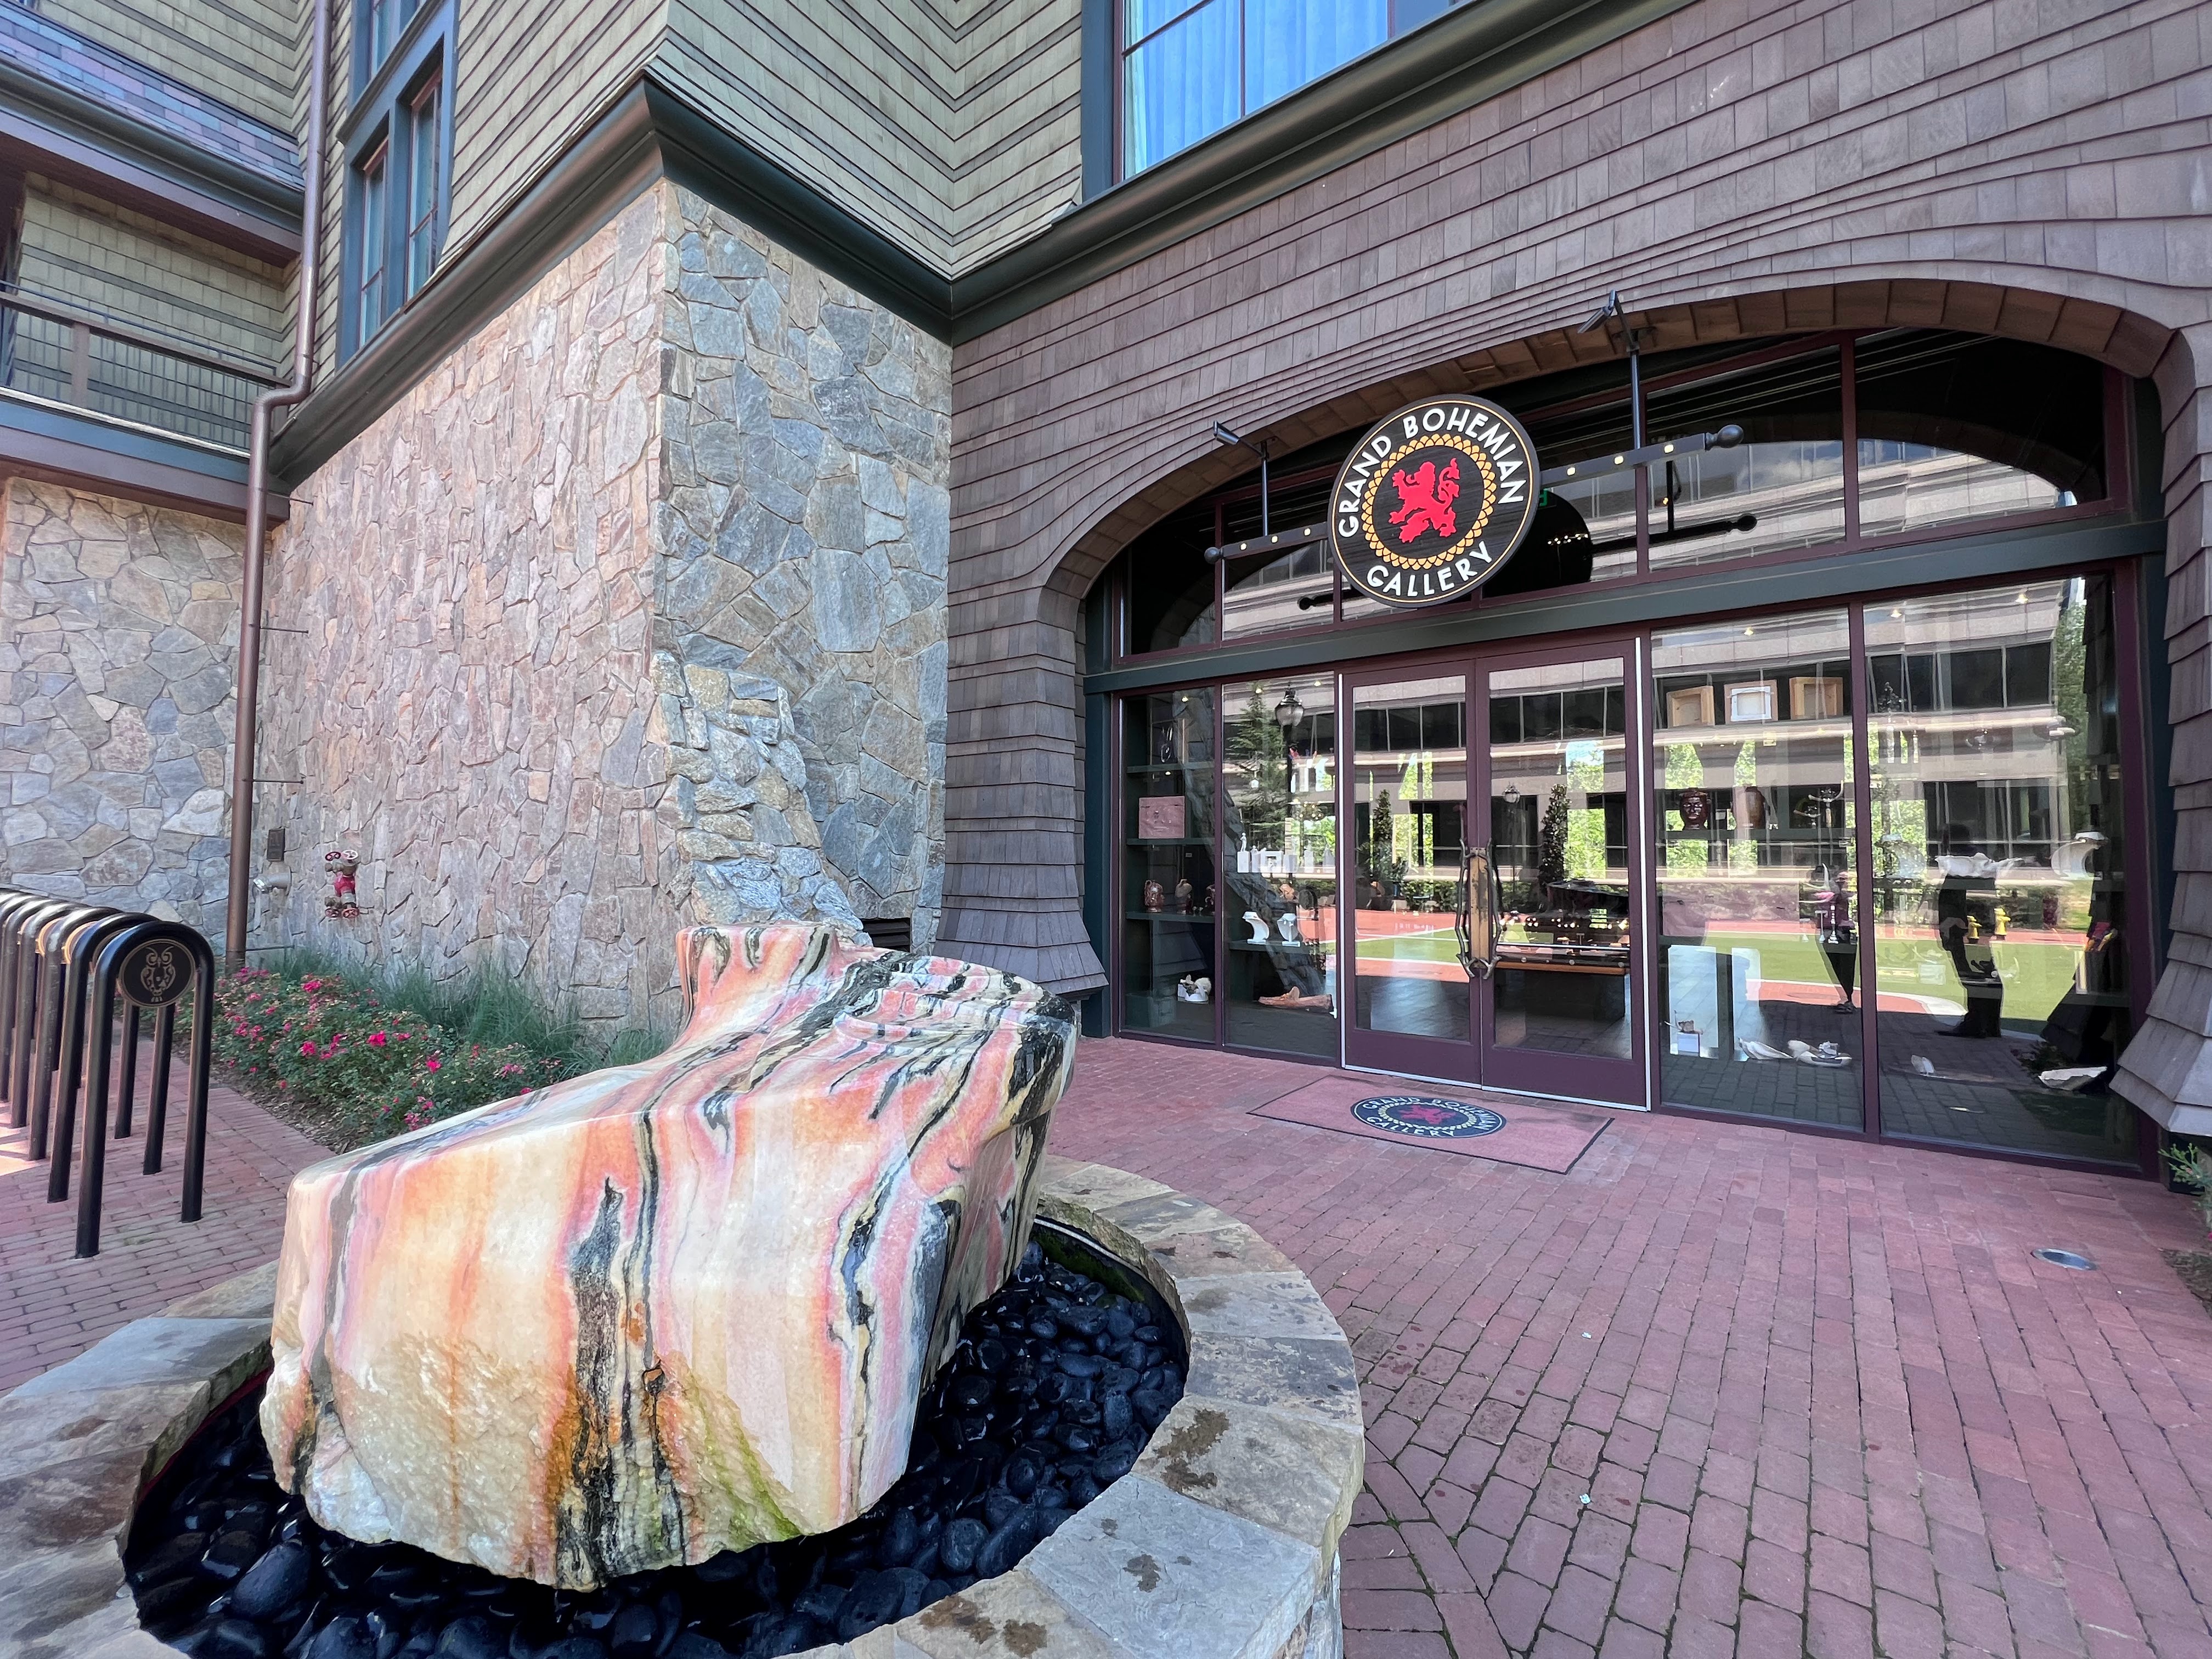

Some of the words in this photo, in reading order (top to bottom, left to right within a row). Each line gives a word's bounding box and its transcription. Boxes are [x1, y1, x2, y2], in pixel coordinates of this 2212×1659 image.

[1338, 436, 1392, 538] GRAND
[1402, 407, 1527, 505] BOHEMIAN
[1367, 540, 1493, 597] GALLERY
[1362, 1097, 1420, 1109] GRAND
[1366, 1116, 1454, 1137] GALLERY
